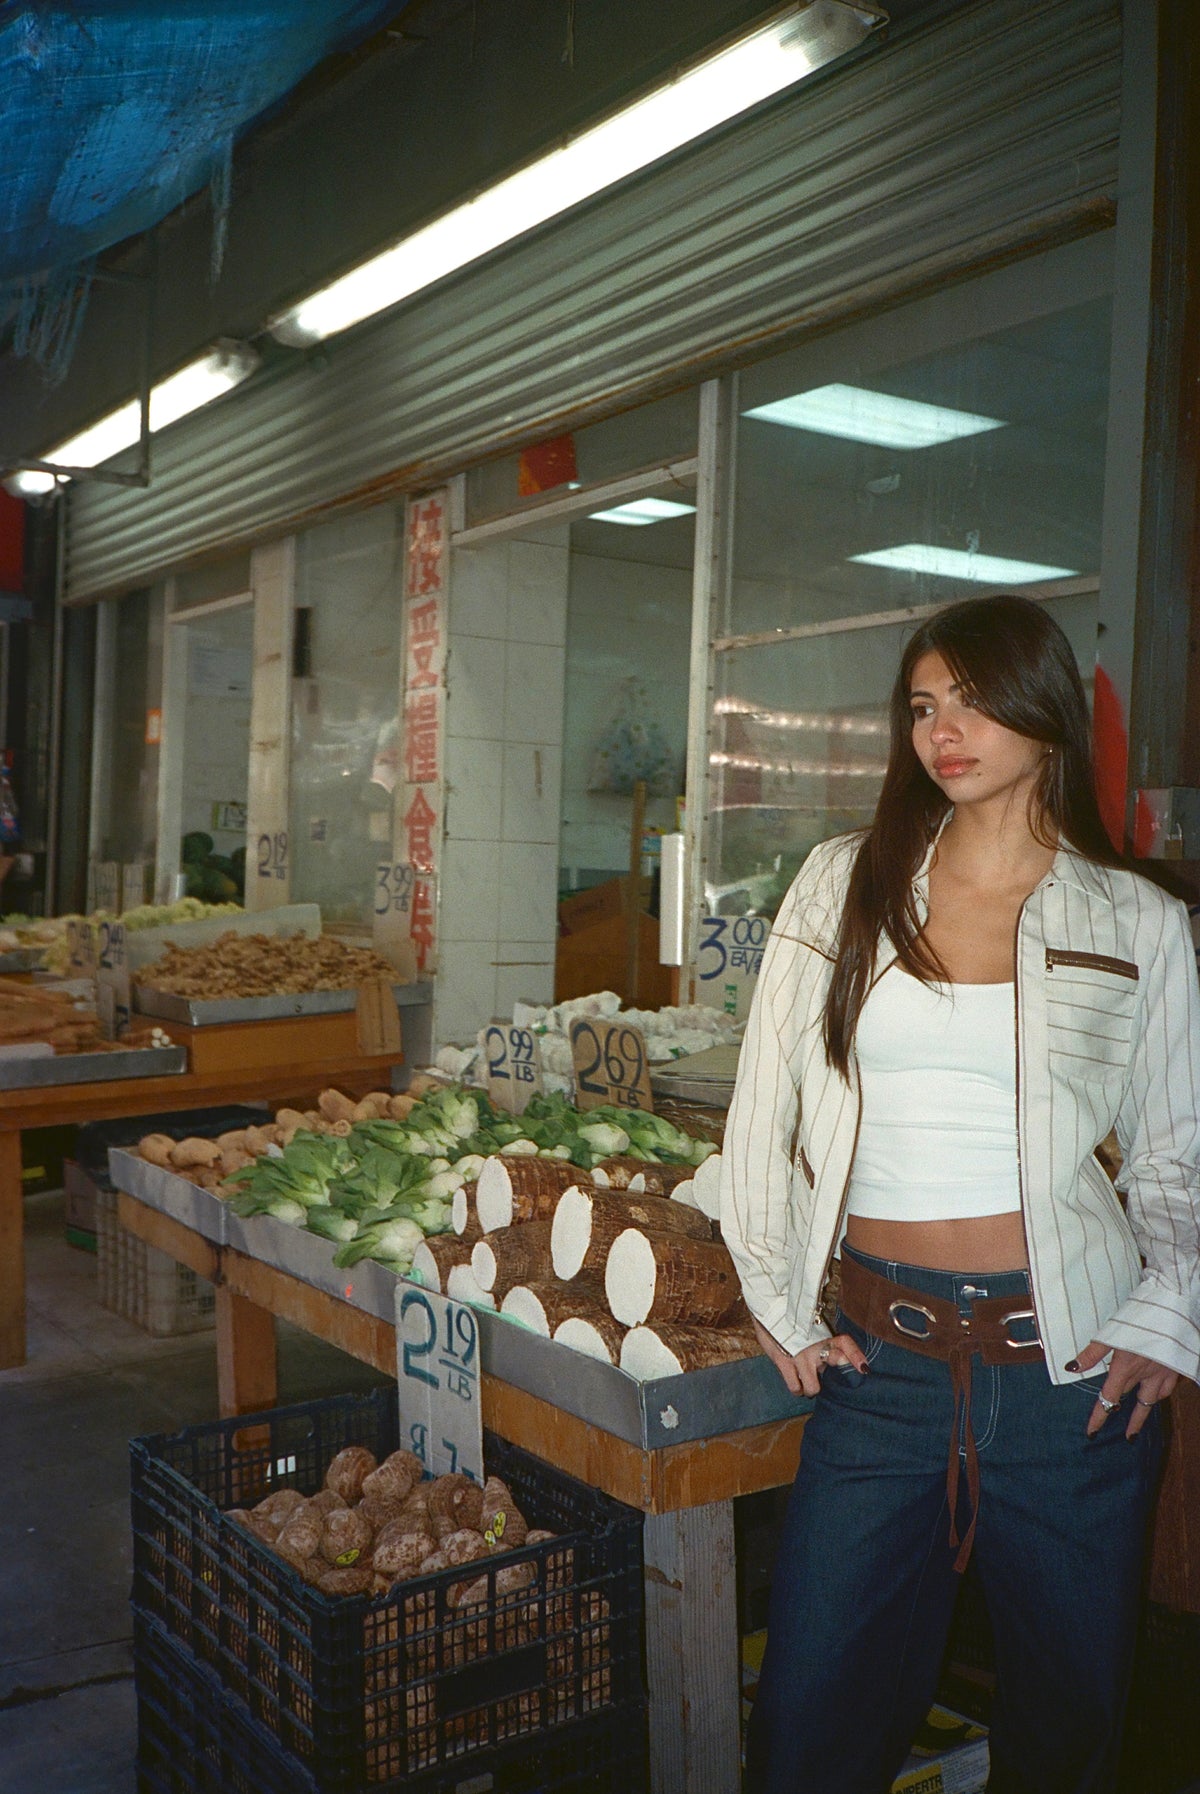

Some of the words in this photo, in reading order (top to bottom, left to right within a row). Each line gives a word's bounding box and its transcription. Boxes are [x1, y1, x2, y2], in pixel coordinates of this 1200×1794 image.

[515, 1063, 535, 1083] LB
[616, 1090, 641, 1108] LB
[448, 1370, 472, 1401] LB
